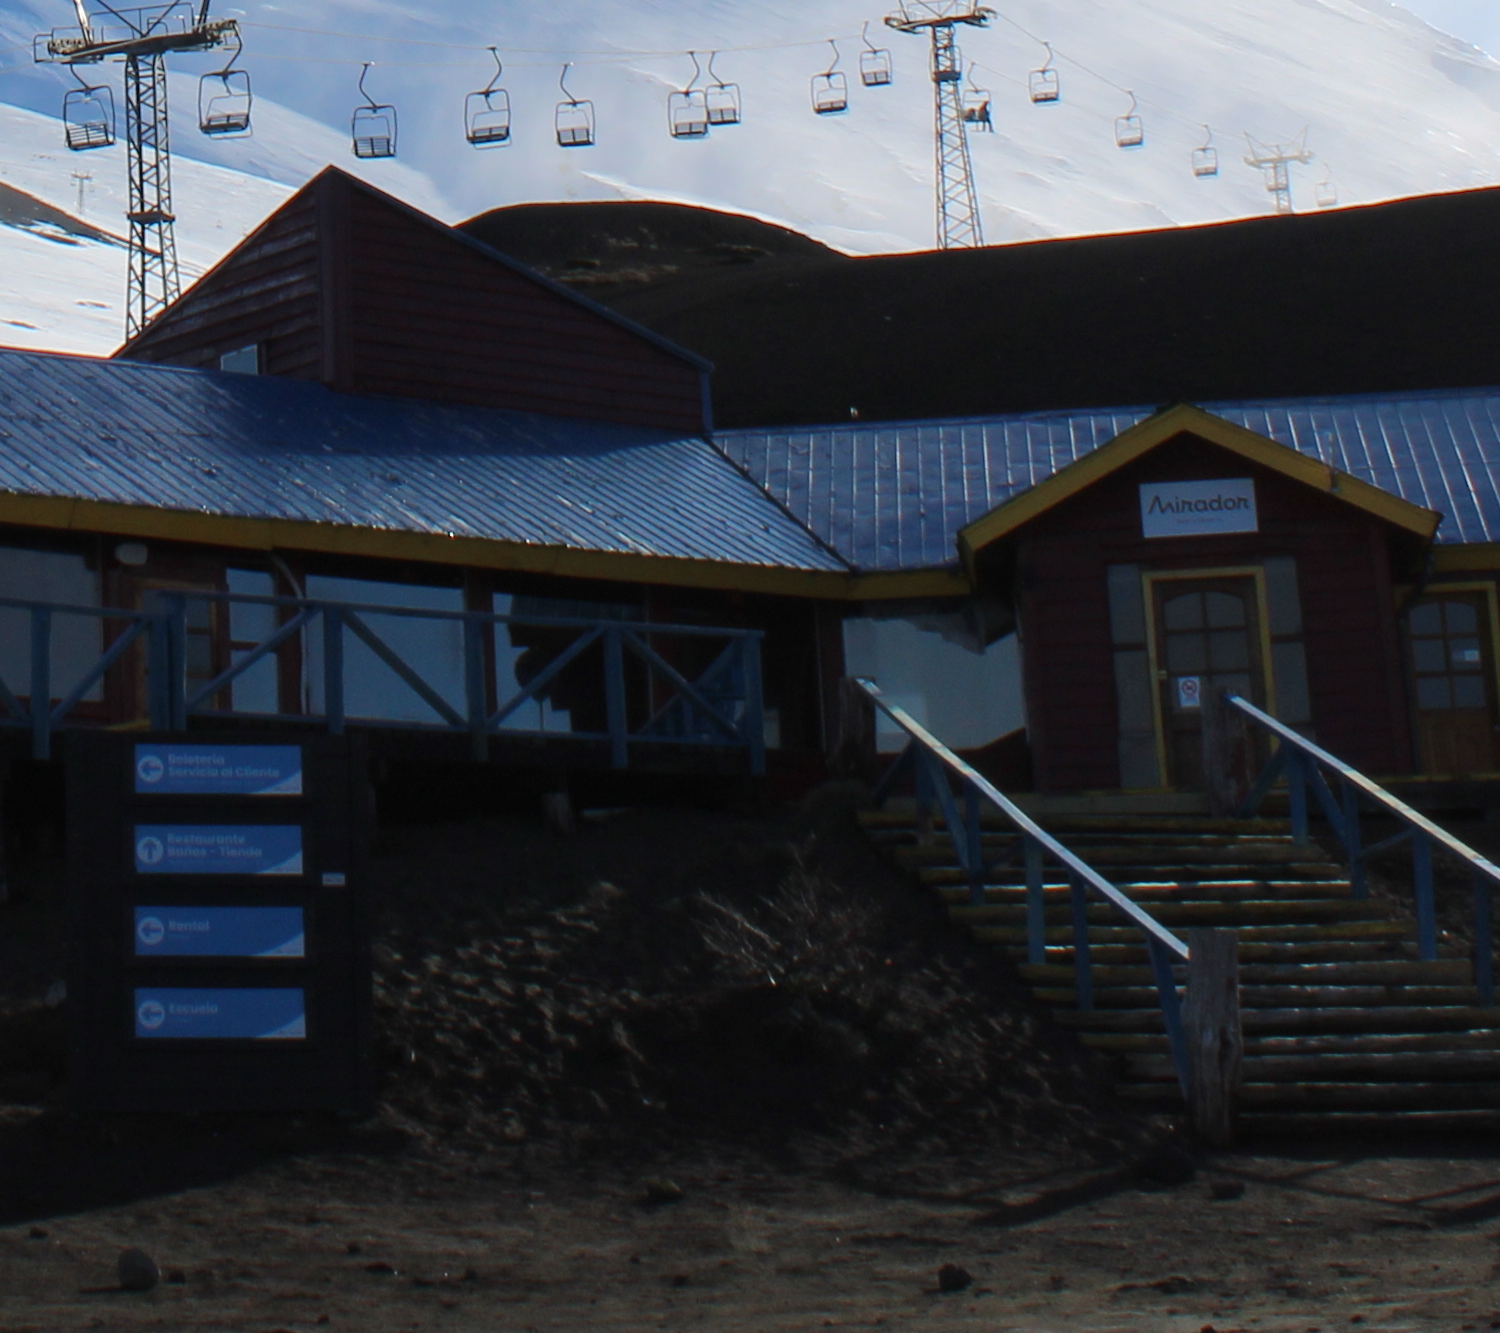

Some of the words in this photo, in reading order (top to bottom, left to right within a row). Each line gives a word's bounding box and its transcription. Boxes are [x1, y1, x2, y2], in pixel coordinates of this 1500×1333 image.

[1147, 493, 1249, 514] Mirador
[168, 764, 218, 777] Servicio
[235, 765, 280, 778] Cliente
[167, 833, 245, 845] Restaurante
[219, 845, 262, 857] Tienda
[169, 919, 210, 931] Rental
[169, 1001, 218, 1014] Escuela
